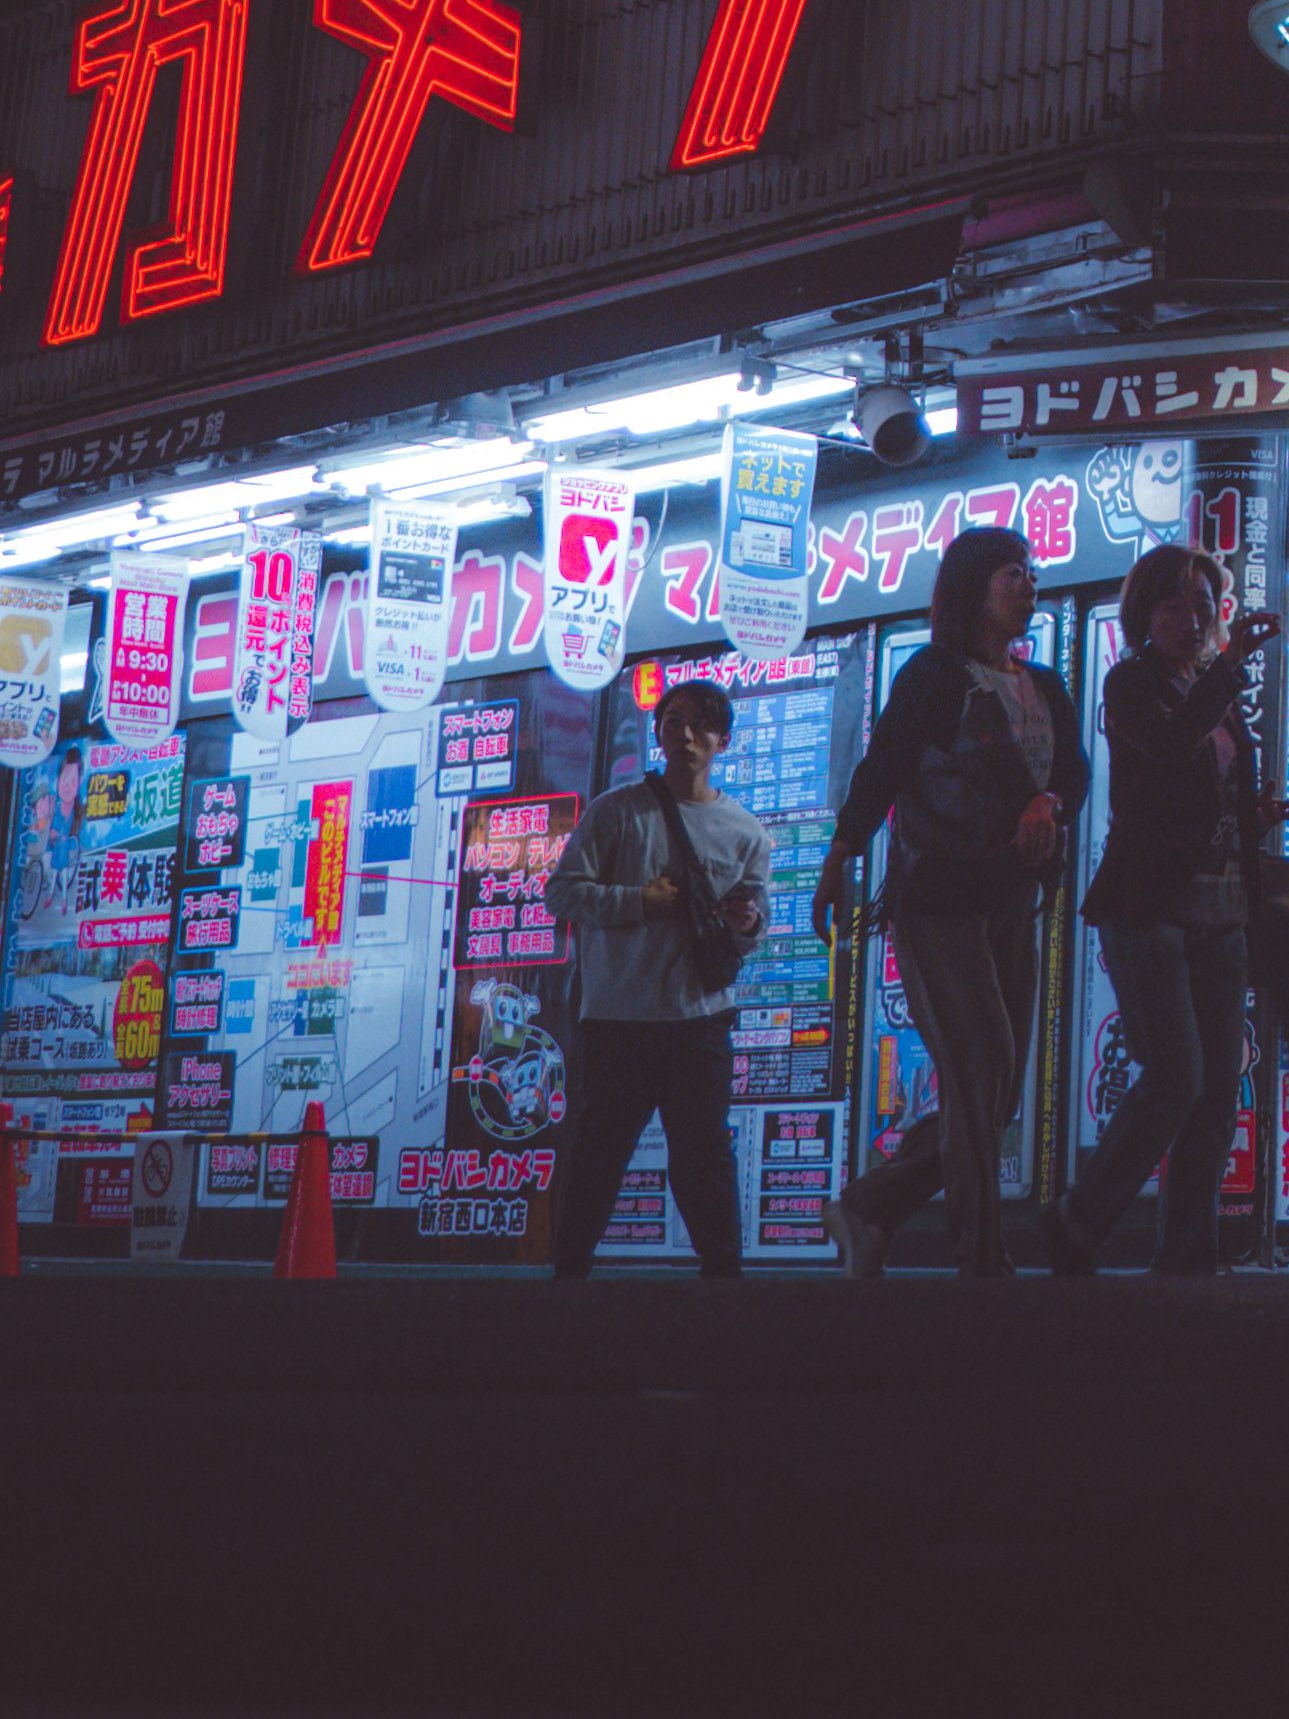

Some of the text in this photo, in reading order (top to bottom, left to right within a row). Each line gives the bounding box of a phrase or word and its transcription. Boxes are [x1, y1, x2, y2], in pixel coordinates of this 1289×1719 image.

[739, 453, 807, 479] ネットで
[559, 492, 627, 513] ヨドバシ
[662, 474, 1078, 625] マメディア館
[124, 593, 168, 621] 営業
[550, 585, 617, 615] アプリで
[122, 617, 166, 646] 時間
[289, 570, 317, 719] 消費税込み表示
[128, 651, 169, 671] 9:30
[376, 661, 405, 676] VISA
[120, 682, 170, 707] 10:00
[640, 662, 657, 705] E
[443, 709, 515, 737] スマートフォン
[445, 733, 509, 763] お酒 自転車
[132, 766, 185, 827] 坂道
[203, 782, 238, 811] ゲーム
[195, 813, 240, 838] おもちゃ
[487, 803, 550, 837] 生活家電
[198, 840, 234, 866] ホビー
[315, 798, 336, 932] このビルです
[463, 839, 519, 873] パソコン
[75, 849, 177, 913] 試乗体験
[181, 891, 240, 919] スーツケース
[468, 905, 516, 932] 美容家電
[186, 918, 232, 949] 旅行用品
[466, 929, 556, 959] 文房具 事務用品
[286, 960, 354, 990] ココにいます
[130, 975, 165, 1014] 75m
[6, 1003, 96, 1033] 当店屋内にある
[181, 1055, 223, 1082] iPhone
[167, 1084, 232, 1109] アクセサリー
[331, 1143, 369, 1170] カメラ
[398, 1148, 557, 1196] ヨドバシカメラ
[417, 1195, 529, 1238] 新宿西口本店
